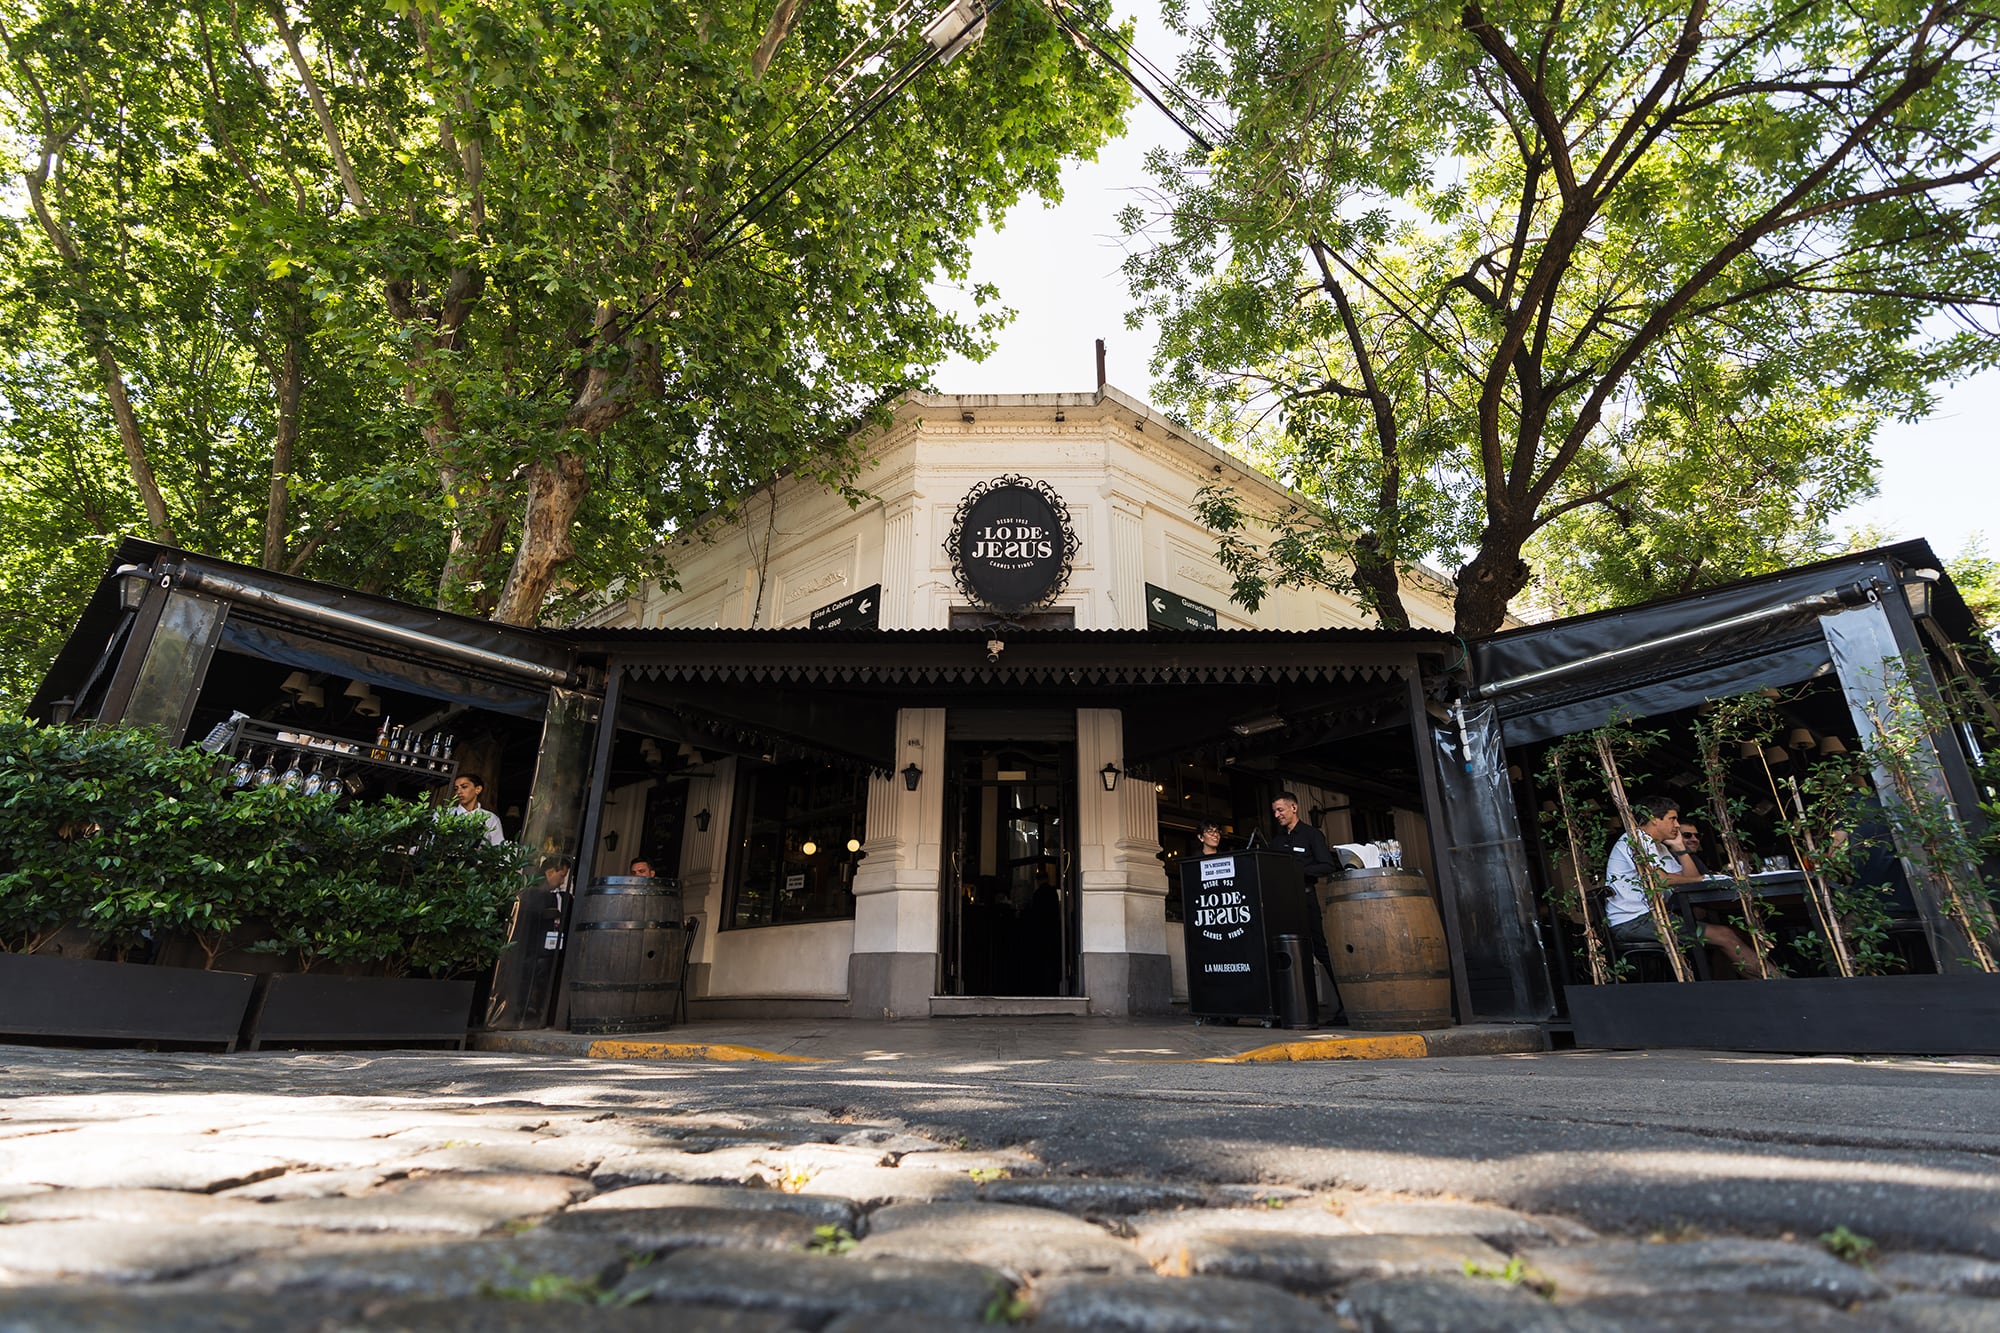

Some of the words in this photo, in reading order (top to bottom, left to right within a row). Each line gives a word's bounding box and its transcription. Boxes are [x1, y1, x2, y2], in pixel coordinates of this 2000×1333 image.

[984, 526, 1011, 540] LO
[1016, 526, 1042, 540] DE
[989, 560, 1011, 570] CARNES
[1018, 560, 1034, 569] VINOS
[1203, 880, 1218, 890] DESDE
[1200, 894, 1219, 908] LO
[1221, 892, 1242, 906] DE
[1203, 930, 1222, 940] CARNES
[1228, 928, 1244, 939] VINOS
[1204, 963, 1213, 973] LA
